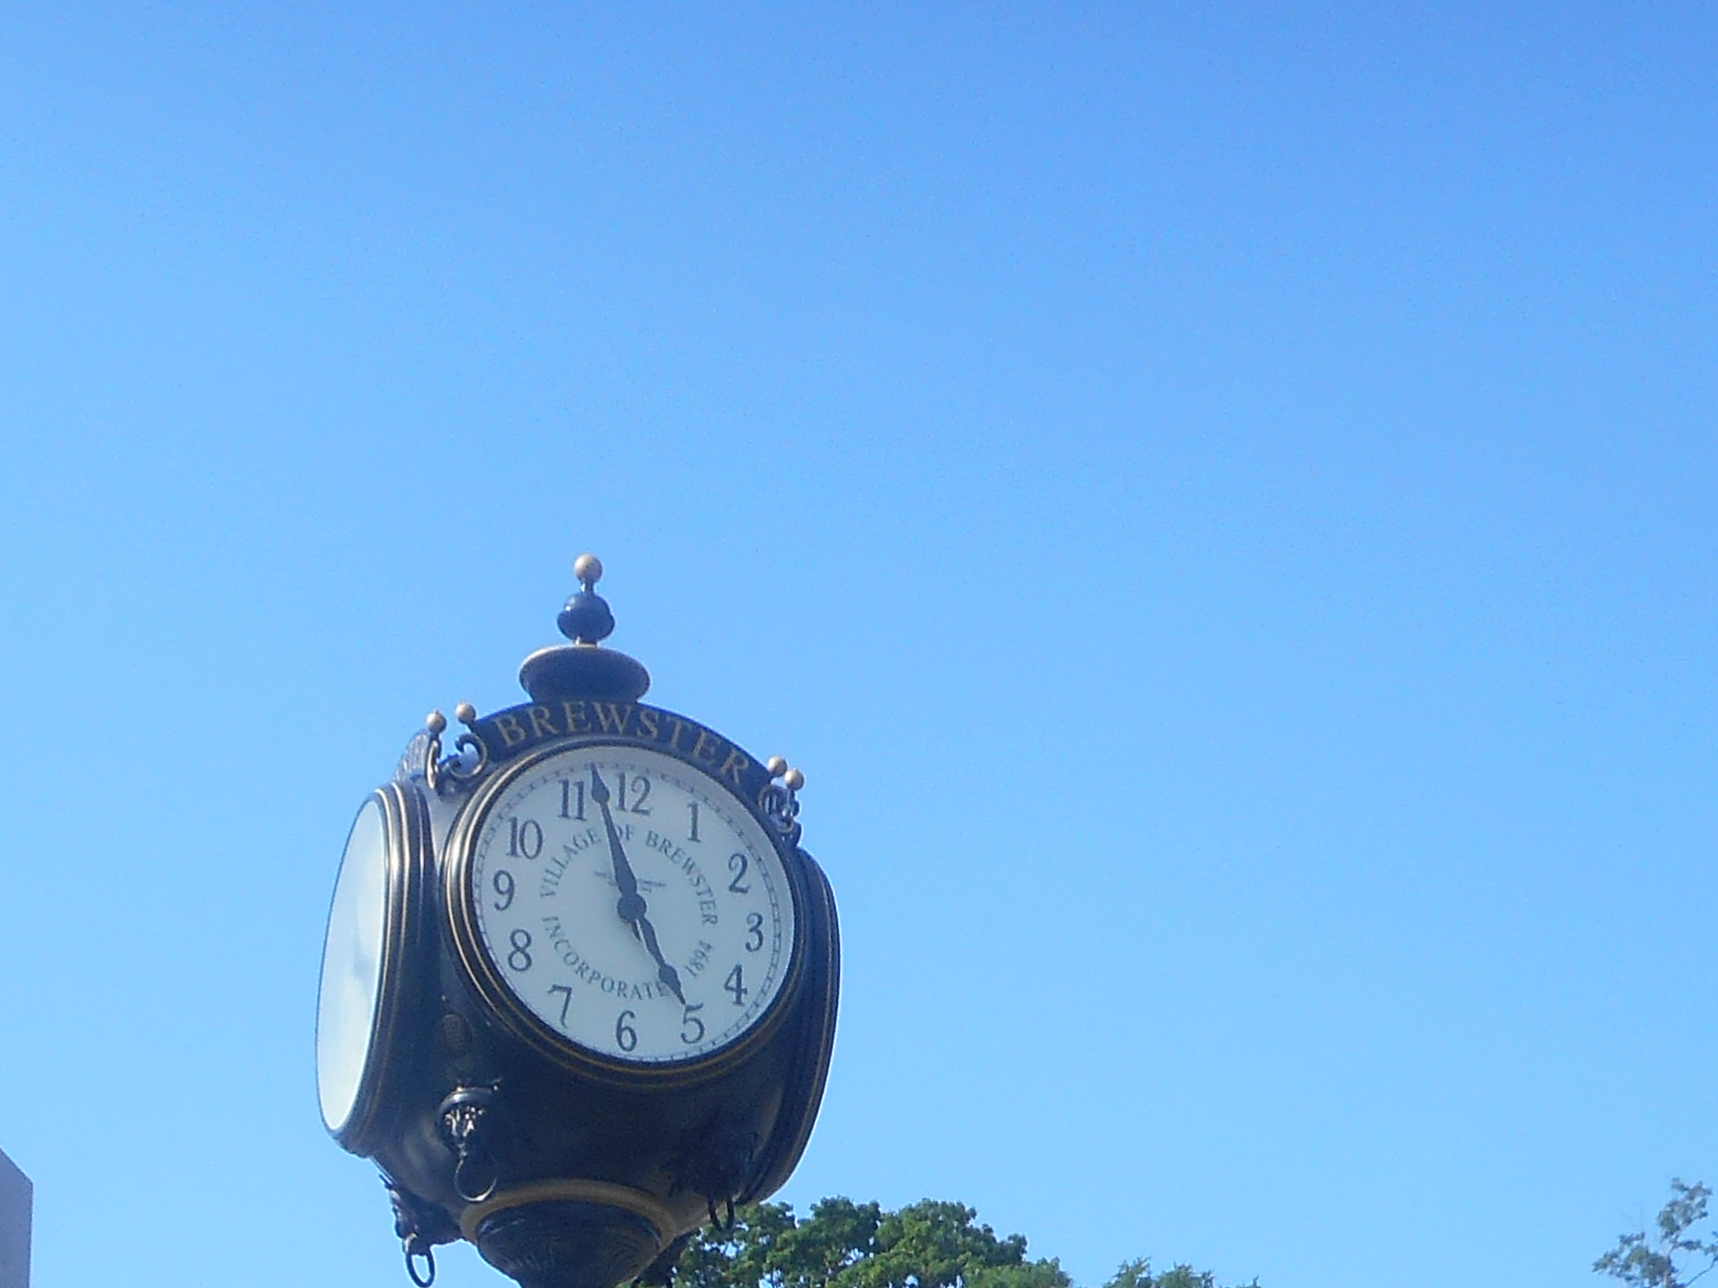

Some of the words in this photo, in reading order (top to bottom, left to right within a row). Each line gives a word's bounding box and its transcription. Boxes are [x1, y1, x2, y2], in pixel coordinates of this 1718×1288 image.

[494, 701, 750, 785] BREWSTER
[559, 779, 587, 822] 11
[614, 773, 654, 817] 12
[507, 817, 544, 861] 10
[686, 803, 703, 843] 1
[493, 869, 516, 912] 9
[540, 827, 602, 898] VILLAGE
[645, 830, 719, 926] BREWSTER
[727, 853, 751, 896] 2
[508, 929, 533, 973] 8
[745, 913, 765, 953] 3
[541, 915, 674, 1001] INCORPORATE
[547, 985, 574, 1028] 7
[725, 964, 749, 1006] 4
[615, 1009, 638, 1053] 6
[680, 1004, 706, 1045] 5
